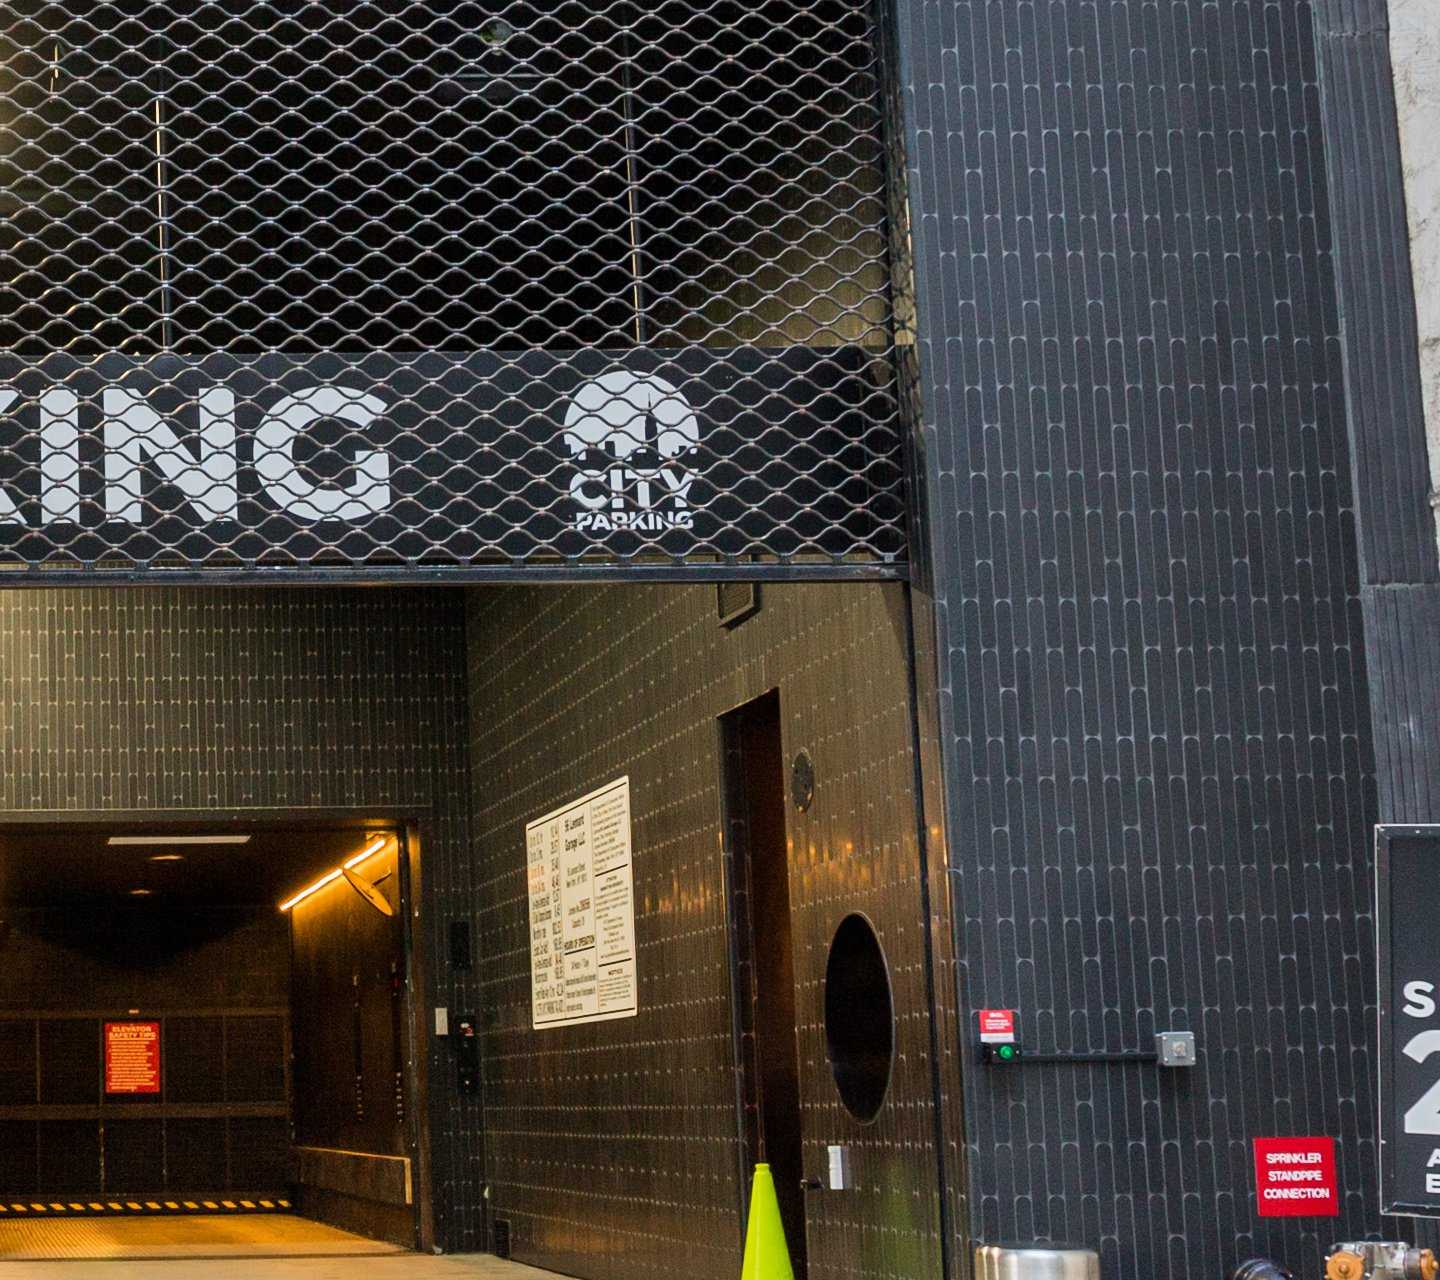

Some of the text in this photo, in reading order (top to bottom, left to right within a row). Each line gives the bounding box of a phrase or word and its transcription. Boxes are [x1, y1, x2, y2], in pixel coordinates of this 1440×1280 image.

[569, 468, 699, 511] CITY
[576, 511, 695, 531] PARKING
[1266, 1153, 1322, 1164] SPRINKLER
[1268, 1171, 1323, 1182] STANDPIPE
[1264, 1188, 1330, 1199] CONNECTION
